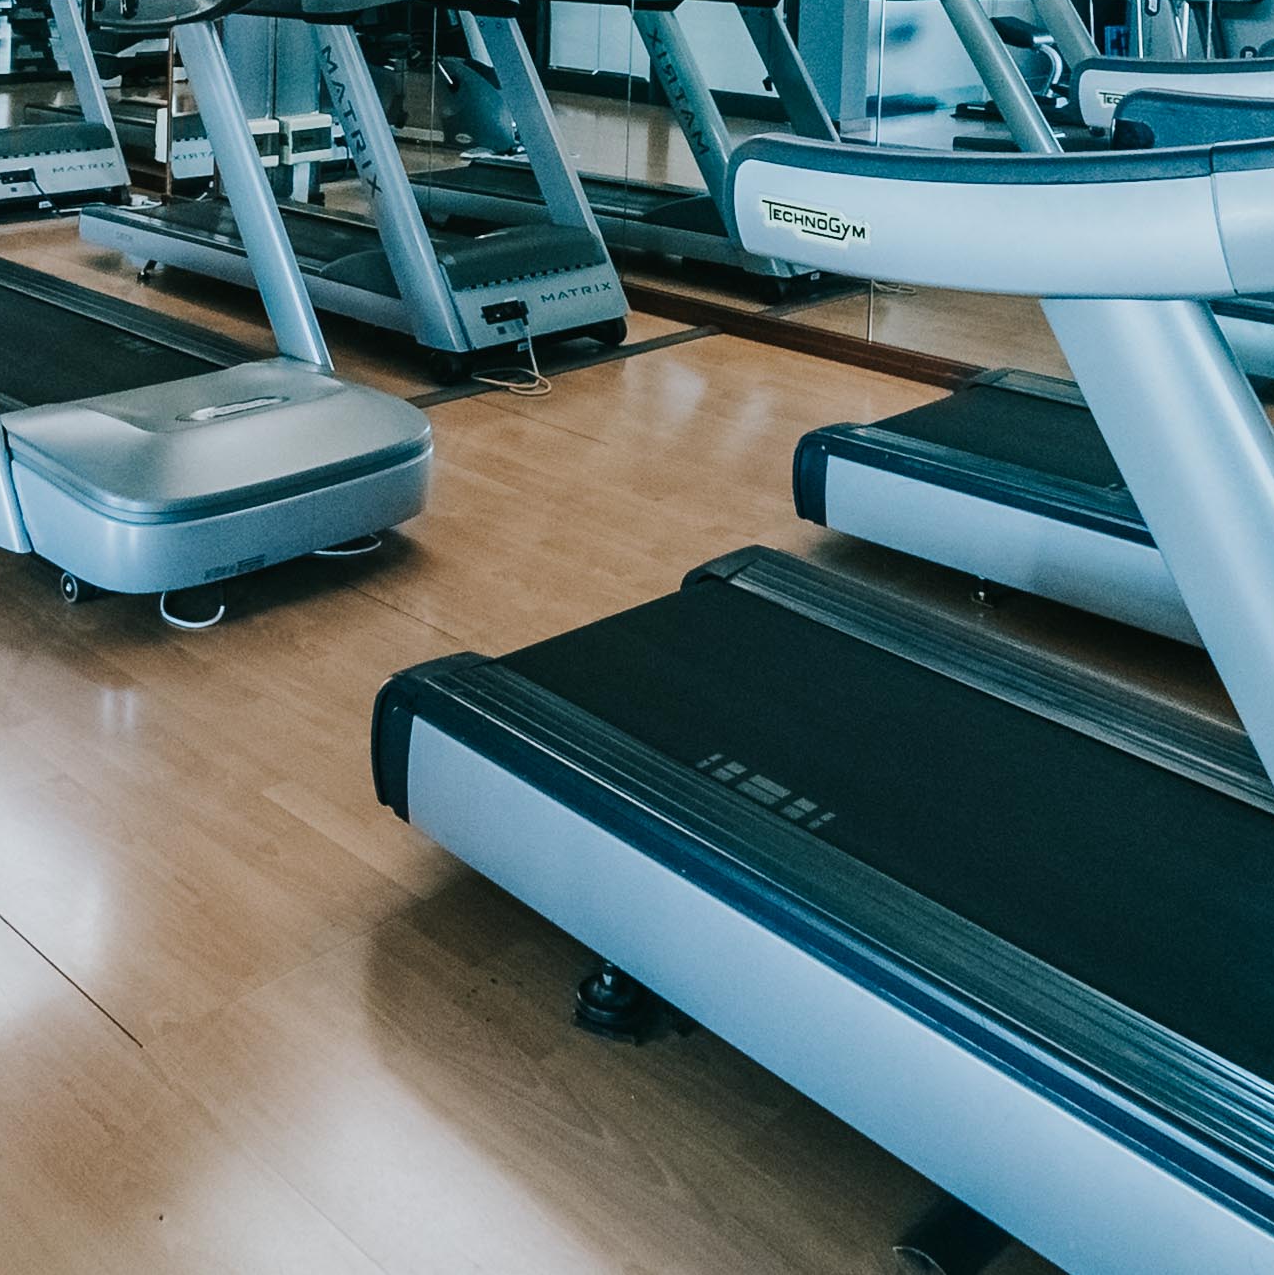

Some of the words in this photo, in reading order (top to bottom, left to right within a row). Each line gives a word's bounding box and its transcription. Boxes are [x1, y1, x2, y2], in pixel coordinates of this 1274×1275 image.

[321, 45, 384, 199] MATRIX
[52, 160, 116, 174] MATRIX
[761, 199, 866, 241] TECHNOGYM
[540, 282, 612, 303] MATRIX
